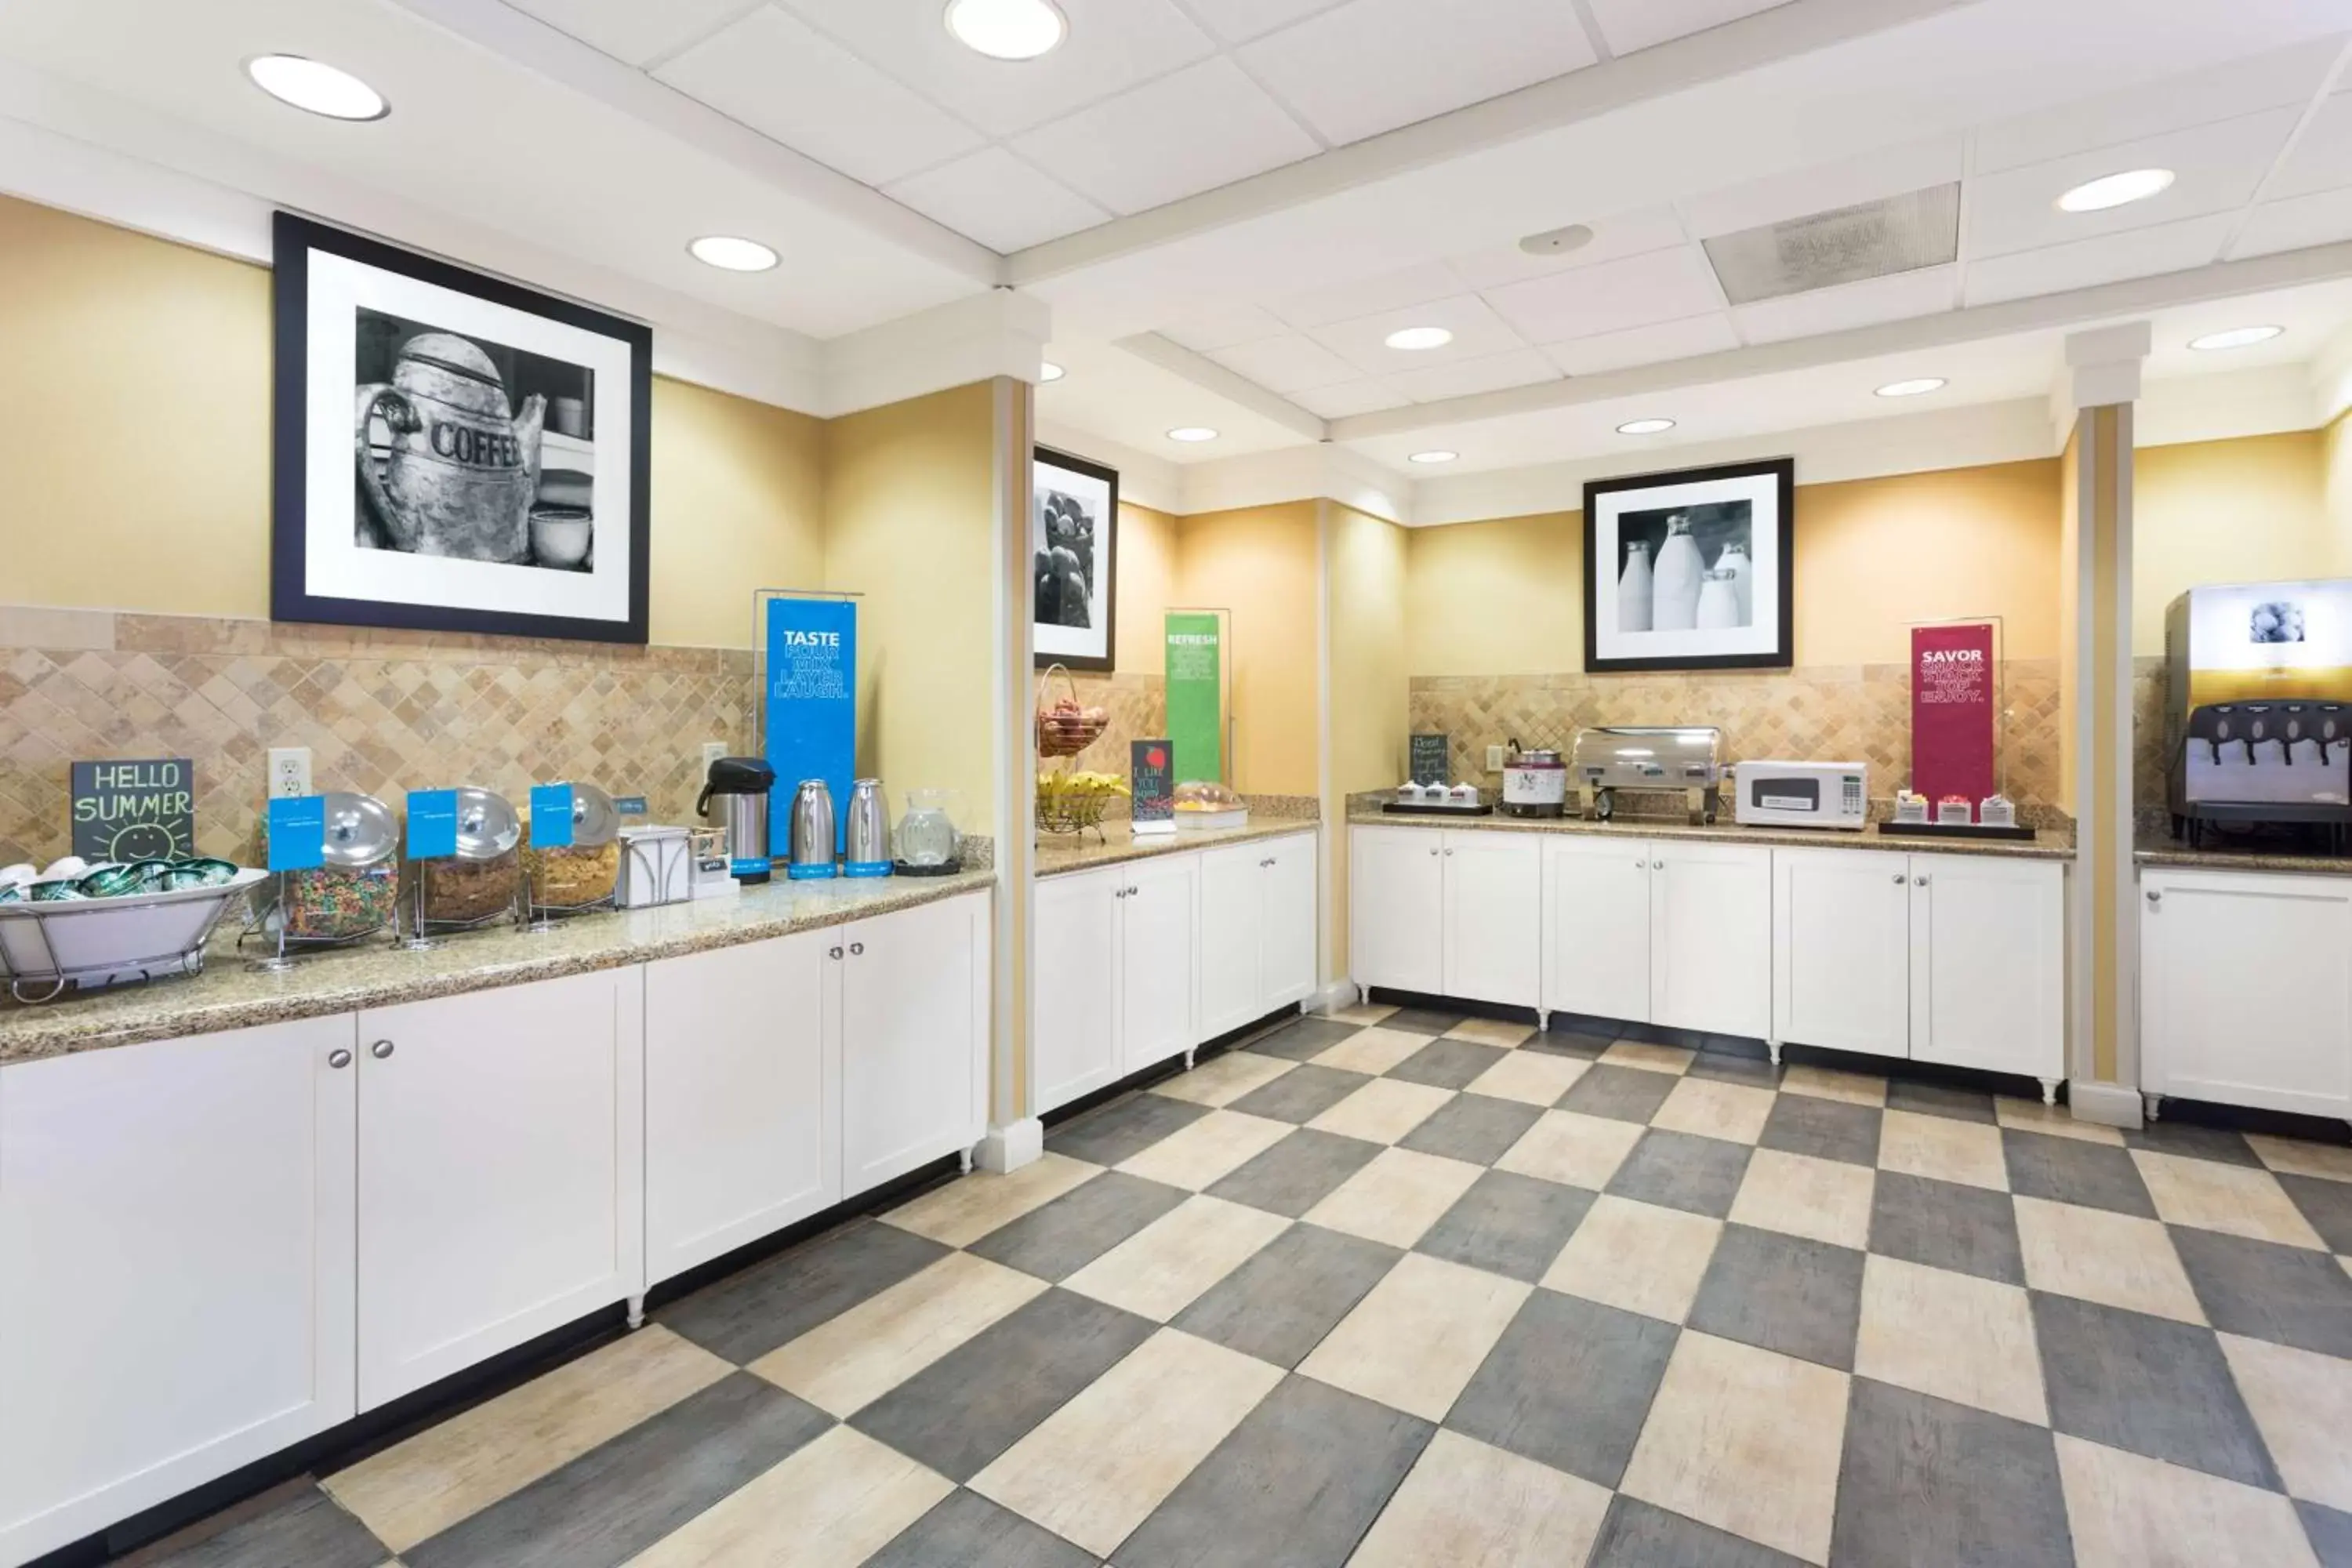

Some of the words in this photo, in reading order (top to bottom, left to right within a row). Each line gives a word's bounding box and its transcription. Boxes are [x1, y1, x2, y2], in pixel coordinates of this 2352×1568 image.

[783, 630, 840, 647] TASTE
[1167, 634, 1217, 644] REFRESH
[1922, 650, 1984, 662] SAVOR
[793, 657, 834, 673] MIX
[780, 669, 842, 685] LAYER
[95, 763, 180, 789] HELLO
[74, 790, 194, 822] SUMMER
